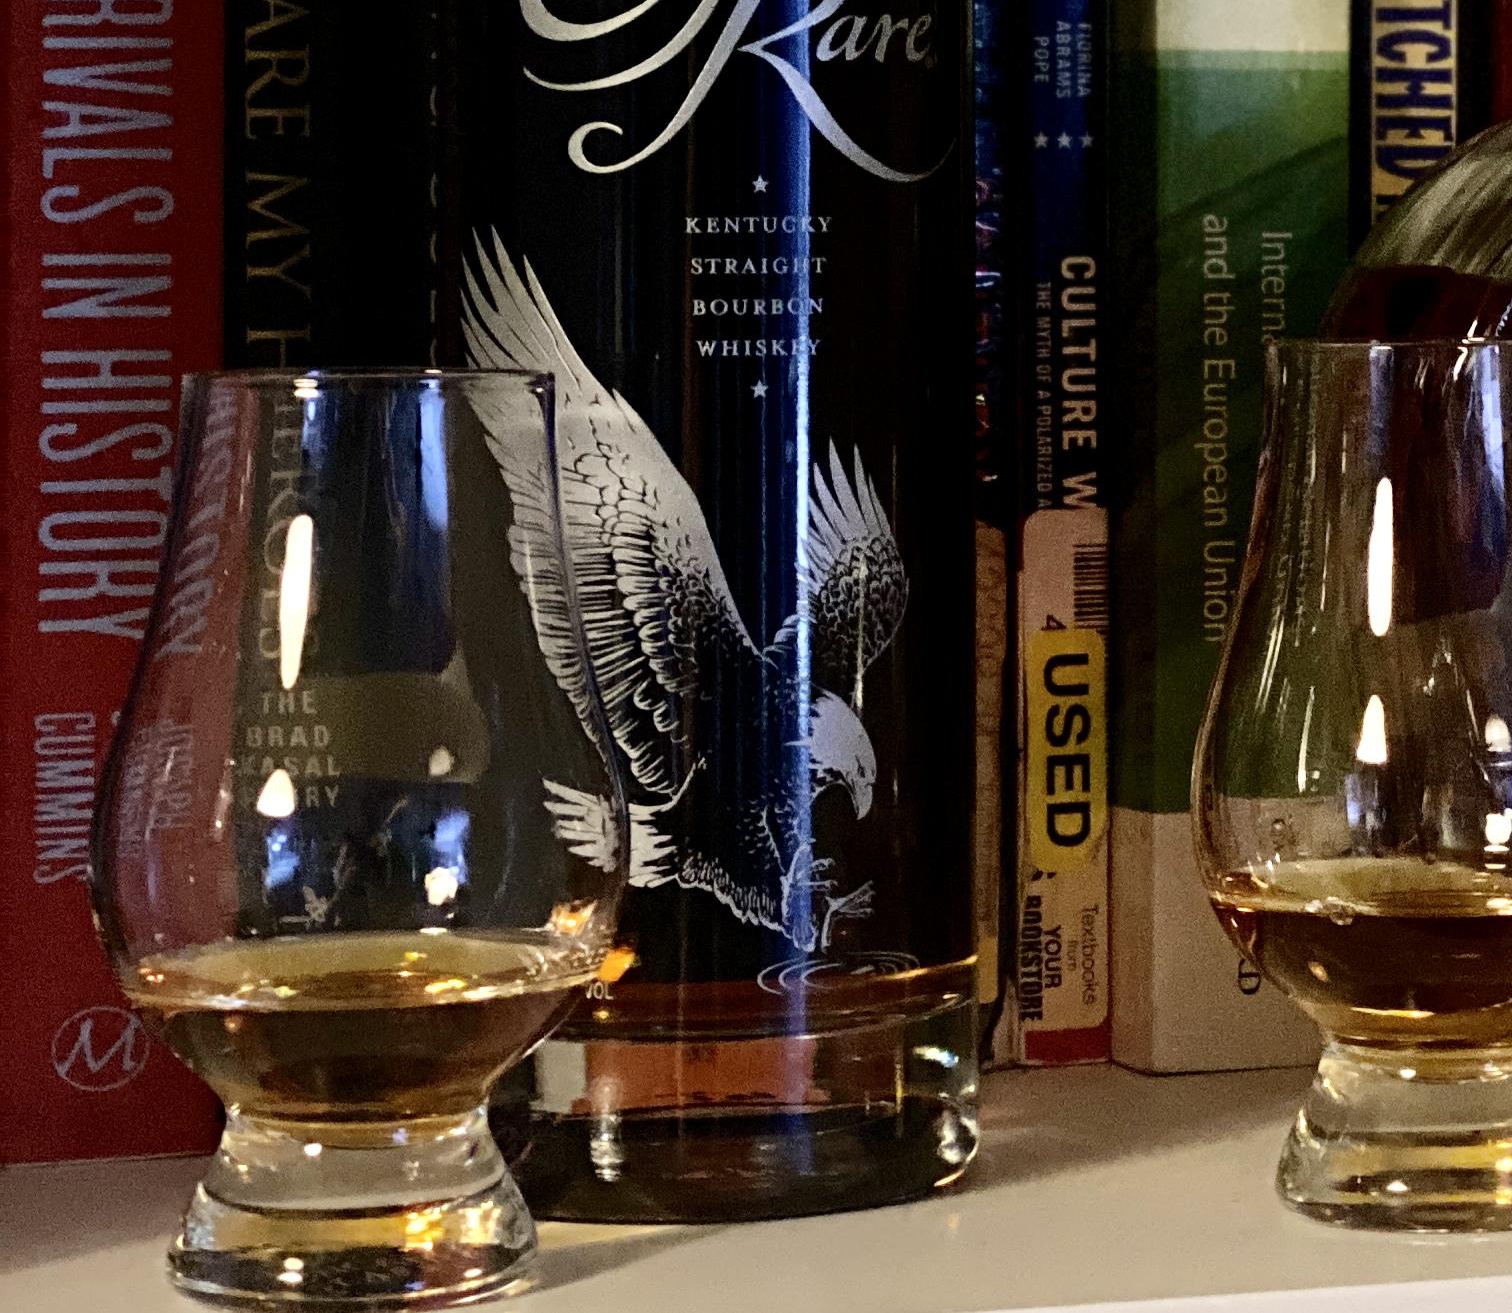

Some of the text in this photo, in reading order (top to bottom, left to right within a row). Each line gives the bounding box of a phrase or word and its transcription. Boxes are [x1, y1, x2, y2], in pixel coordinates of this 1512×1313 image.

[1032, 36, 1051, 84] POPE
[1055, 20, 1073, 99] ABRAMS
[245, 171, 312, 300] MY
[685, 216, 832, 234] KENTUCKY
[41, 251, 173, 321] IN
[690, 257, 827, 275] STRAIGHT
[1034, 281, 1052, 310] THE
[692, 298, 823, 316] BOURBON
[1034, 315, 1052, 358] MYTH
[696, 339, 821, 357] WHISKEY
[1035, 363, 1053, 384] OF
[1060, 254, 1098, 450] CULTURE
[1036, 388, 1053, 400] A
[1036, 404, 1055, 493] POLARIZED
[1194, 214, 1236, 642] and the European Union
[37, 348, 174, 640] HISTORY
[261, 690, 317, 714] THE
[246, 725, 330, 748] BRAD
[1043, 653, 1091, 847] USED
[33, 712, 97, 884] CUMMINS
[1020, 894, 1044, 1022] BOOKSTORE
[1043, 924, 1063, 989] YOUR
[1080, 904, 1100, 1005] Textbooks
